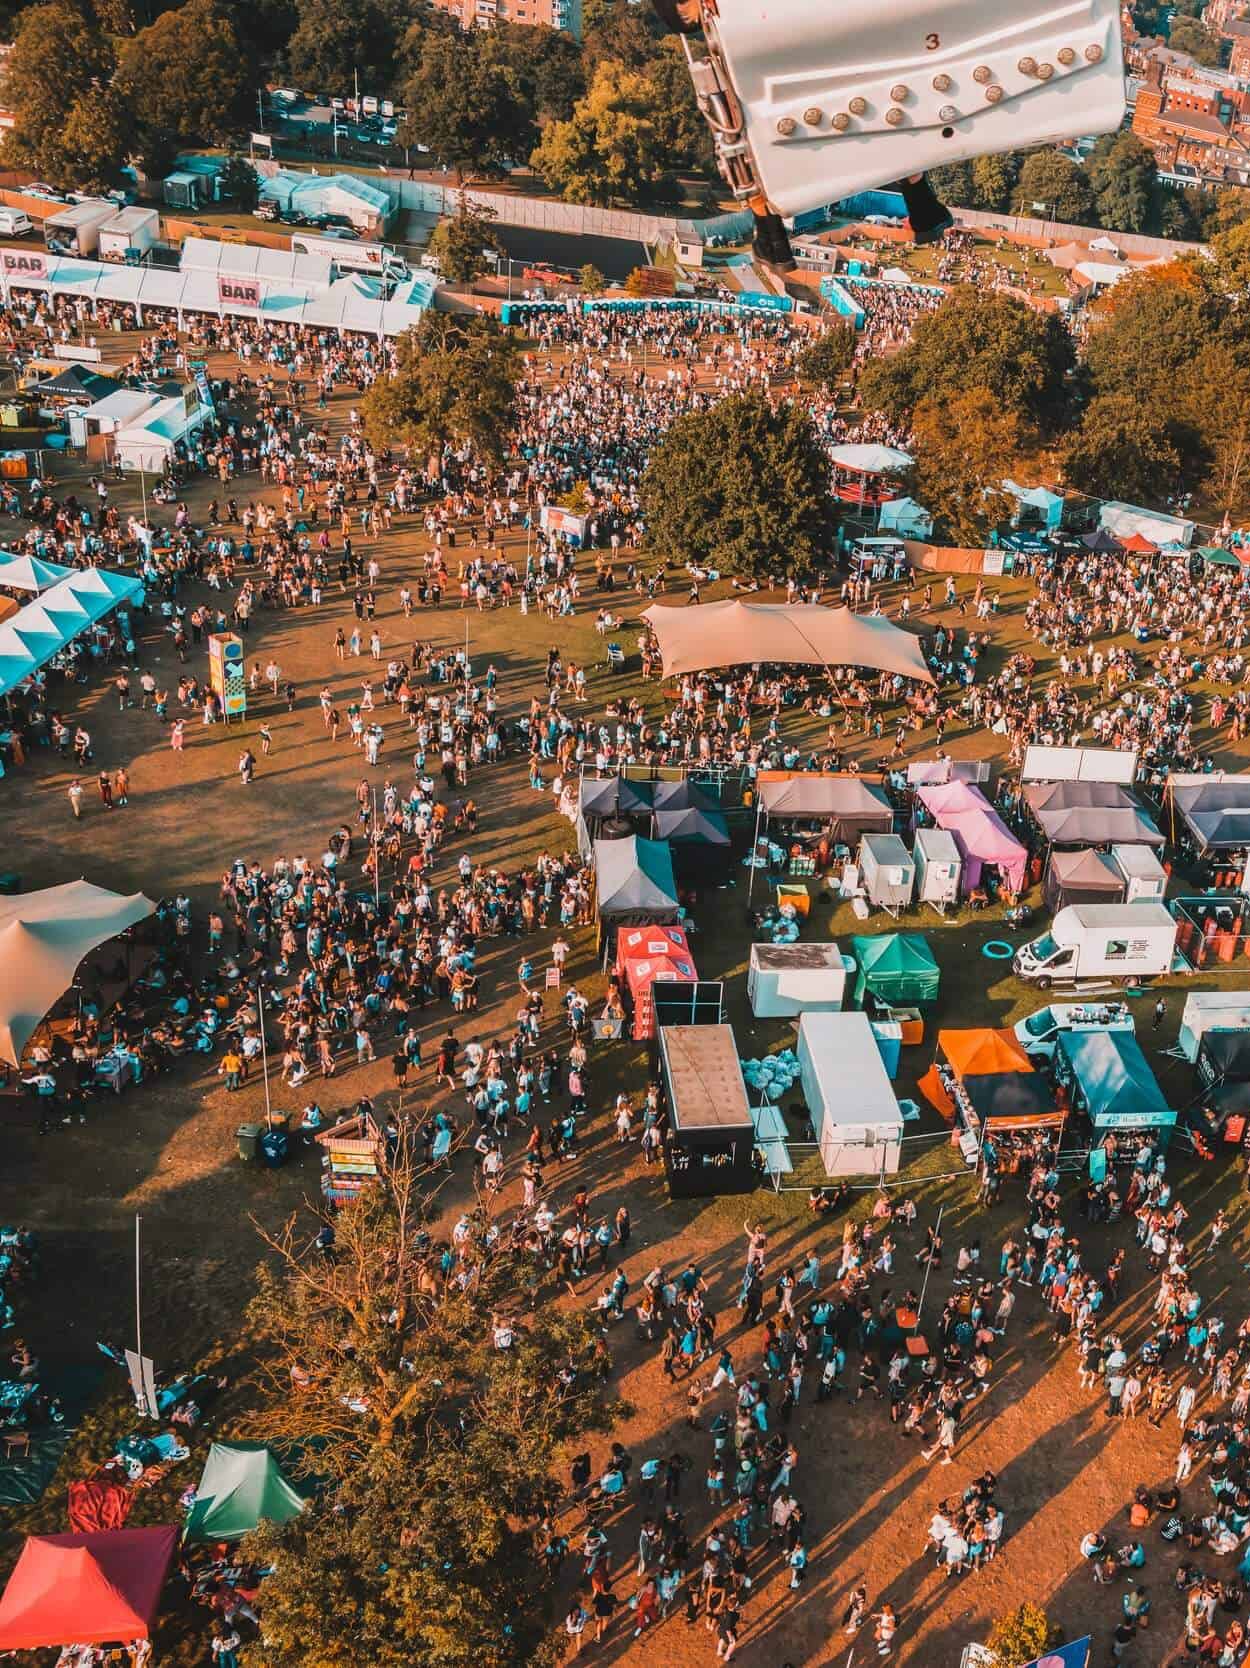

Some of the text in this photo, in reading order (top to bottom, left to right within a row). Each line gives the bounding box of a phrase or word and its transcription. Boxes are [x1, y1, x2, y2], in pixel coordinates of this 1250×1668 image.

[925, 33, 940, 50] 3
[4, 255, 42, 271] BAR
[221, 285, 257, 300] BAR
